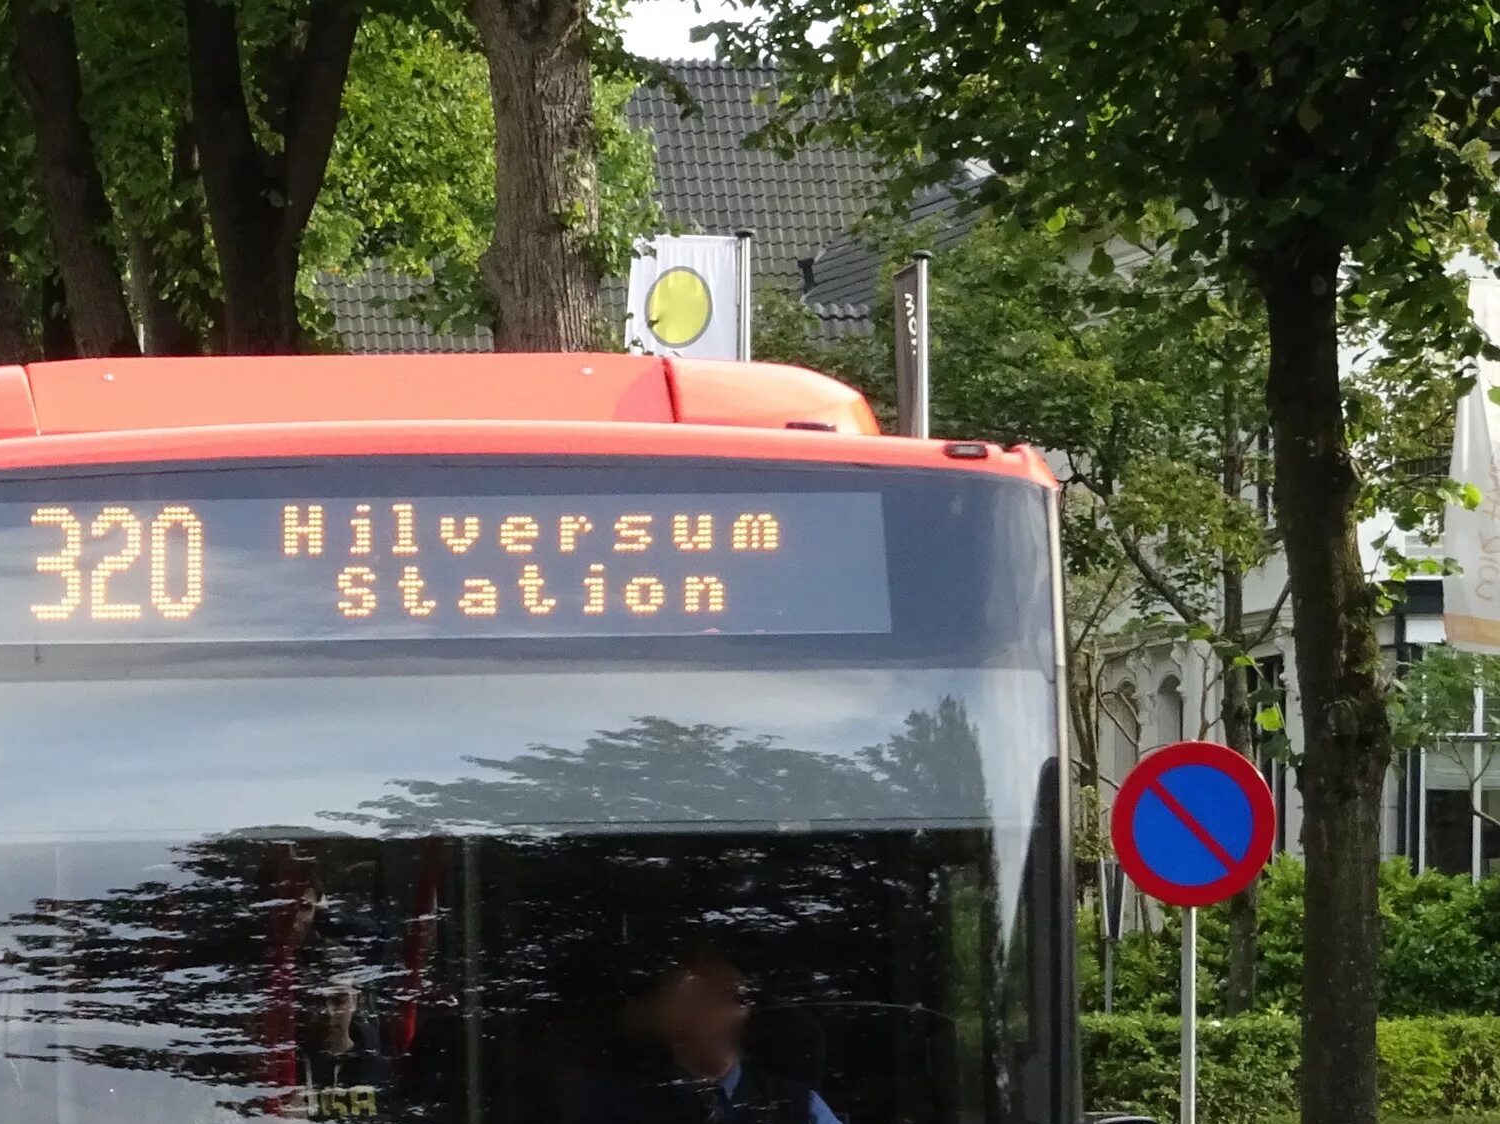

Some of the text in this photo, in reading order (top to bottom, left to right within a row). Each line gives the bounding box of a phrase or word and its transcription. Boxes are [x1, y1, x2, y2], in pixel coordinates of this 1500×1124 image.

[30, 503, 779, 620] 320 Hilversum
[337, 563, 726, 617] Station
